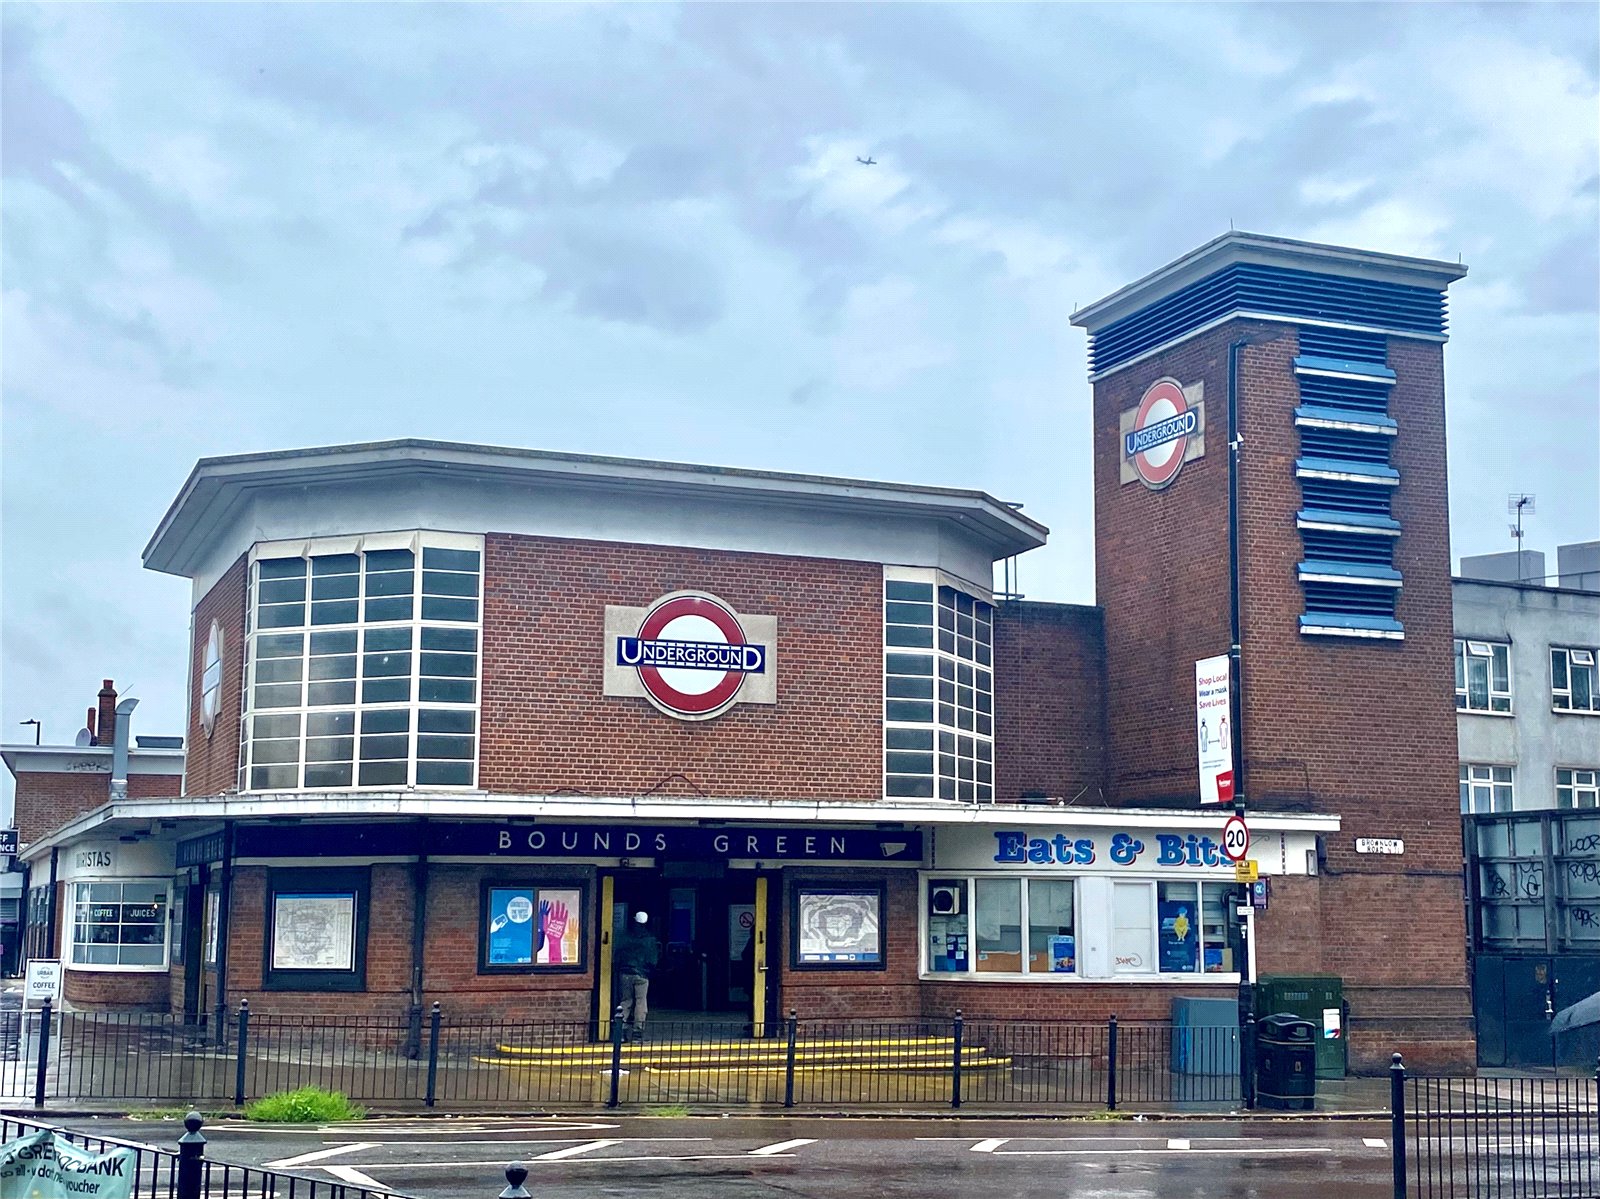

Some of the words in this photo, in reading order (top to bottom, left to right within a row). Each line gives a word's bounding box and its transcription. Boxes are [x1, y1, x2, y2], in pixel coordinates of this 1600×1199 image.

[1126, 411, 1196, 455] UNDERGROUND
[621, 639, 762, 671] UNDERGROUND
[1198, 677, 1212, 686] Shop
[1213, 674, 1227, 682] Local
[1215, 686, 1227, 694] mask
[1198, 701, 1212, 709] Save
[499, 831, 667, 852] BOUNDS
[713, 834, 846, 855] GREEN
[1226, 829, 1245, 848] 20
[1361, 838, 1398, 847] BROWNLOW
[993, 831, 1097, 865] Eats
[1109, 833, 1144, 865] &
[1156, 834, 1236, 867] Bits
[1367, 846, 1384, 854] ROAD
[94, 908, 113, 917] COFFEE
[130, 908, 156, 918] JUICES
[32, 981, 56, 989] COFFEE
